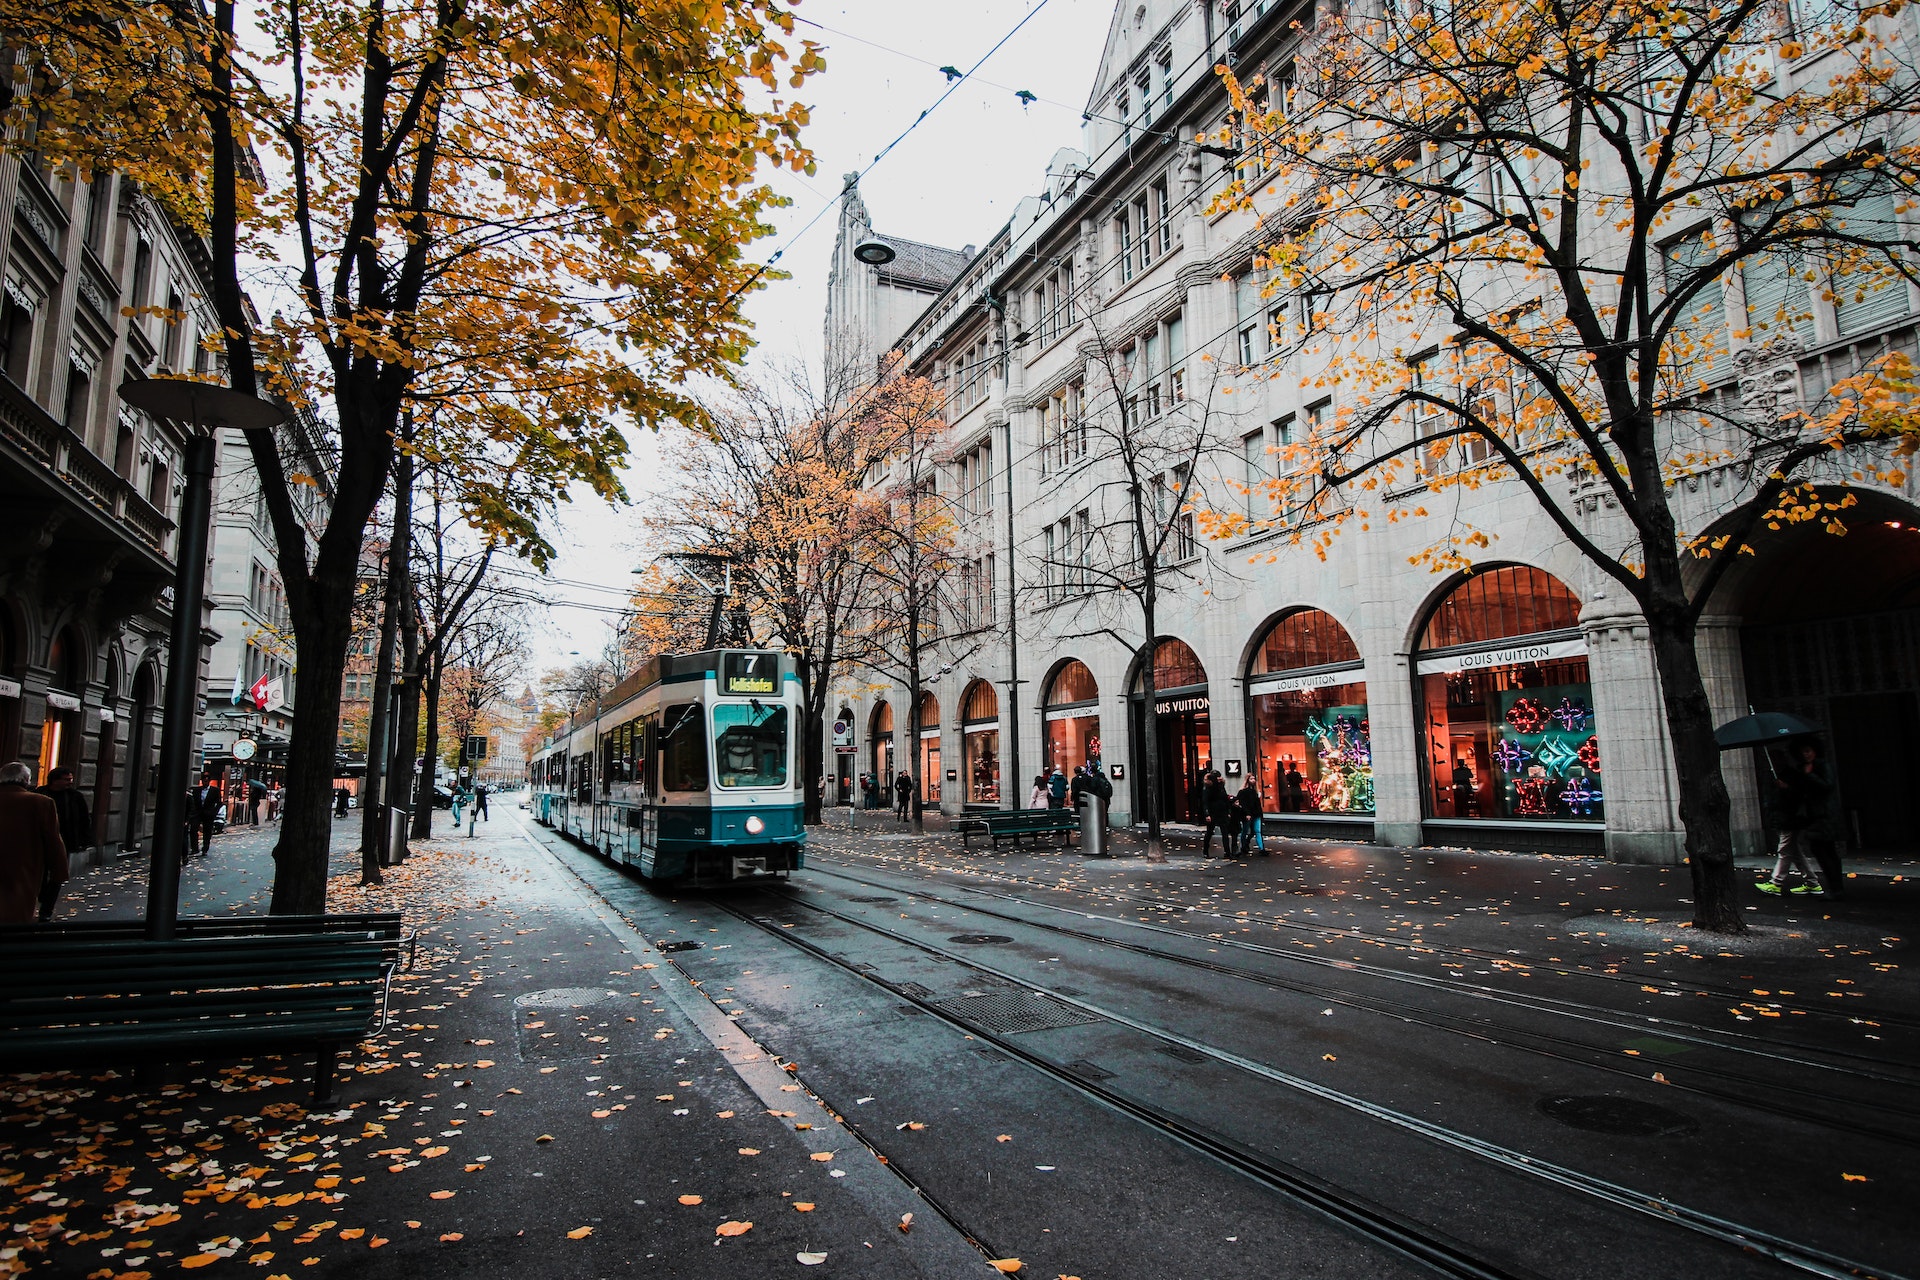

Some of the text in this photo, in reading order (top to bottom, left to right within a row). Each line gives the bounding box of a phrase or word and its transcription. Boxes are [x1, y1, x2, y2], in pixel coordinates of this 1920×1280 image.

[744, 655, 759, 674] 7
[1459, 646, 1550, 667] LOUIS VUITTON
[1277, 675, 1336, 690] LOUIS VUITTON
[1155, 697, 1211, 714] UIS VUITTON
